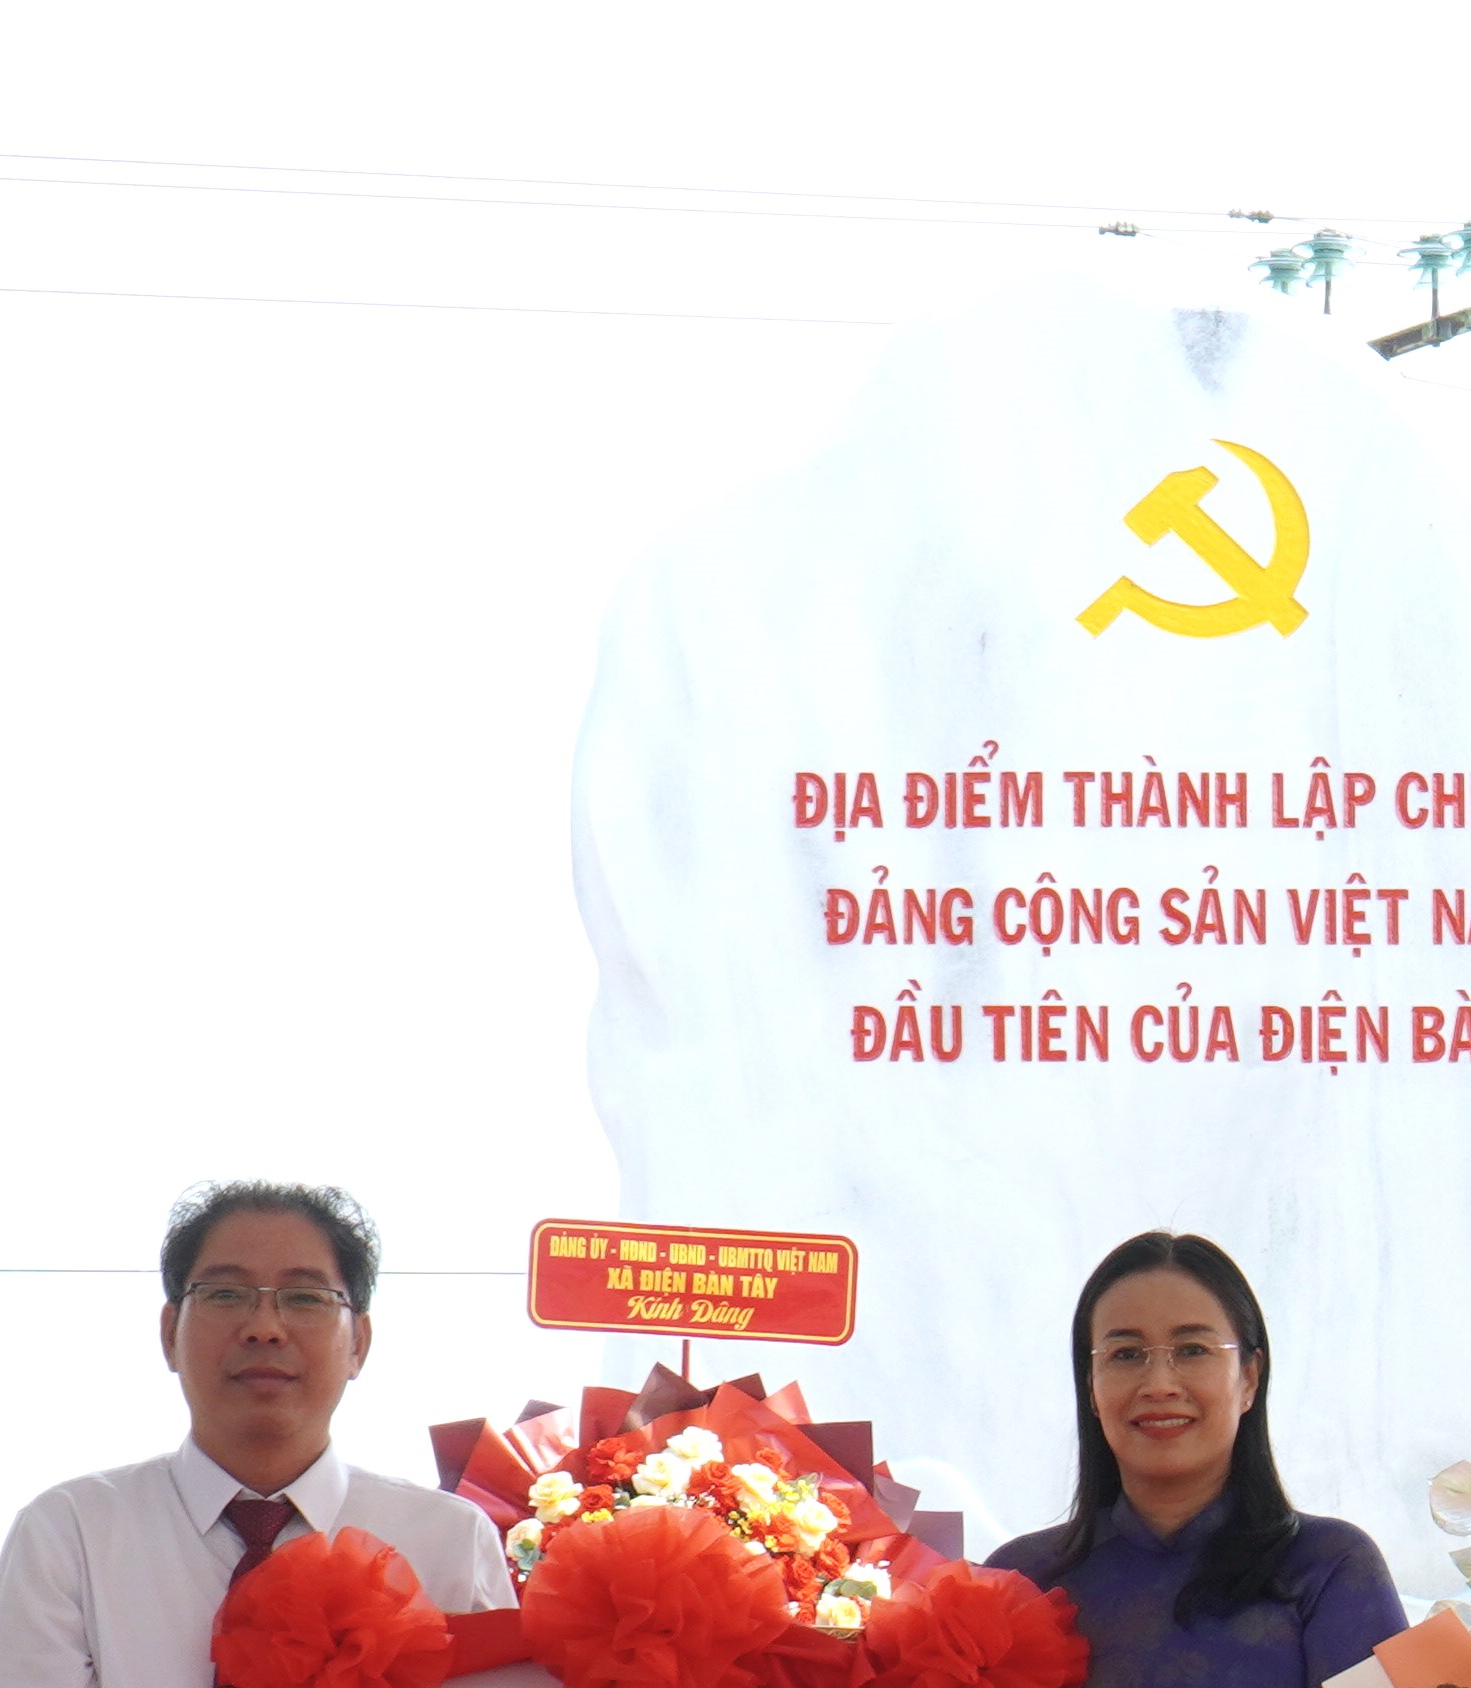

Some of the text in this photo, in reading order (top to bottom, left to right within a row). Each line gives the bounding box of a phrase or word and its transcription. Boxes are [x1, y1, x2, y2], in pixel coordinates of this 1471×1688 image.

[793, 773, 882, 840] ĐỊA
[904, 741, 1042, 827] ĐIỂM
[1064, 757, 1247, 826] THÀNH
[1273, 757, 1375, 838] LẬP
[825, 867, 973, 944] ĐẢNG
[994, 873, 1139, 954] CỘNG
[1161, 866, 1265, 944] SẢN
[1288, 874, 1408, 955] VIỆT
[851, 980, 961, 1062] ĐẦU
[983, 990, 1108, 1061] TIÊN
[1131, 983, 1237, 1061] CỦA
[1259, 991, 1388, 1072] ĐIỆN
[549, 1231, 838, 1275] ĐẢNG ỦY HĐND UBND UBMTTQ VIỆT NAM
[607, 1265, 778, 1299] XÃ ĐIỆN BÀN TÂY
[627, 1295, 755, 1331] Kính Dâng
